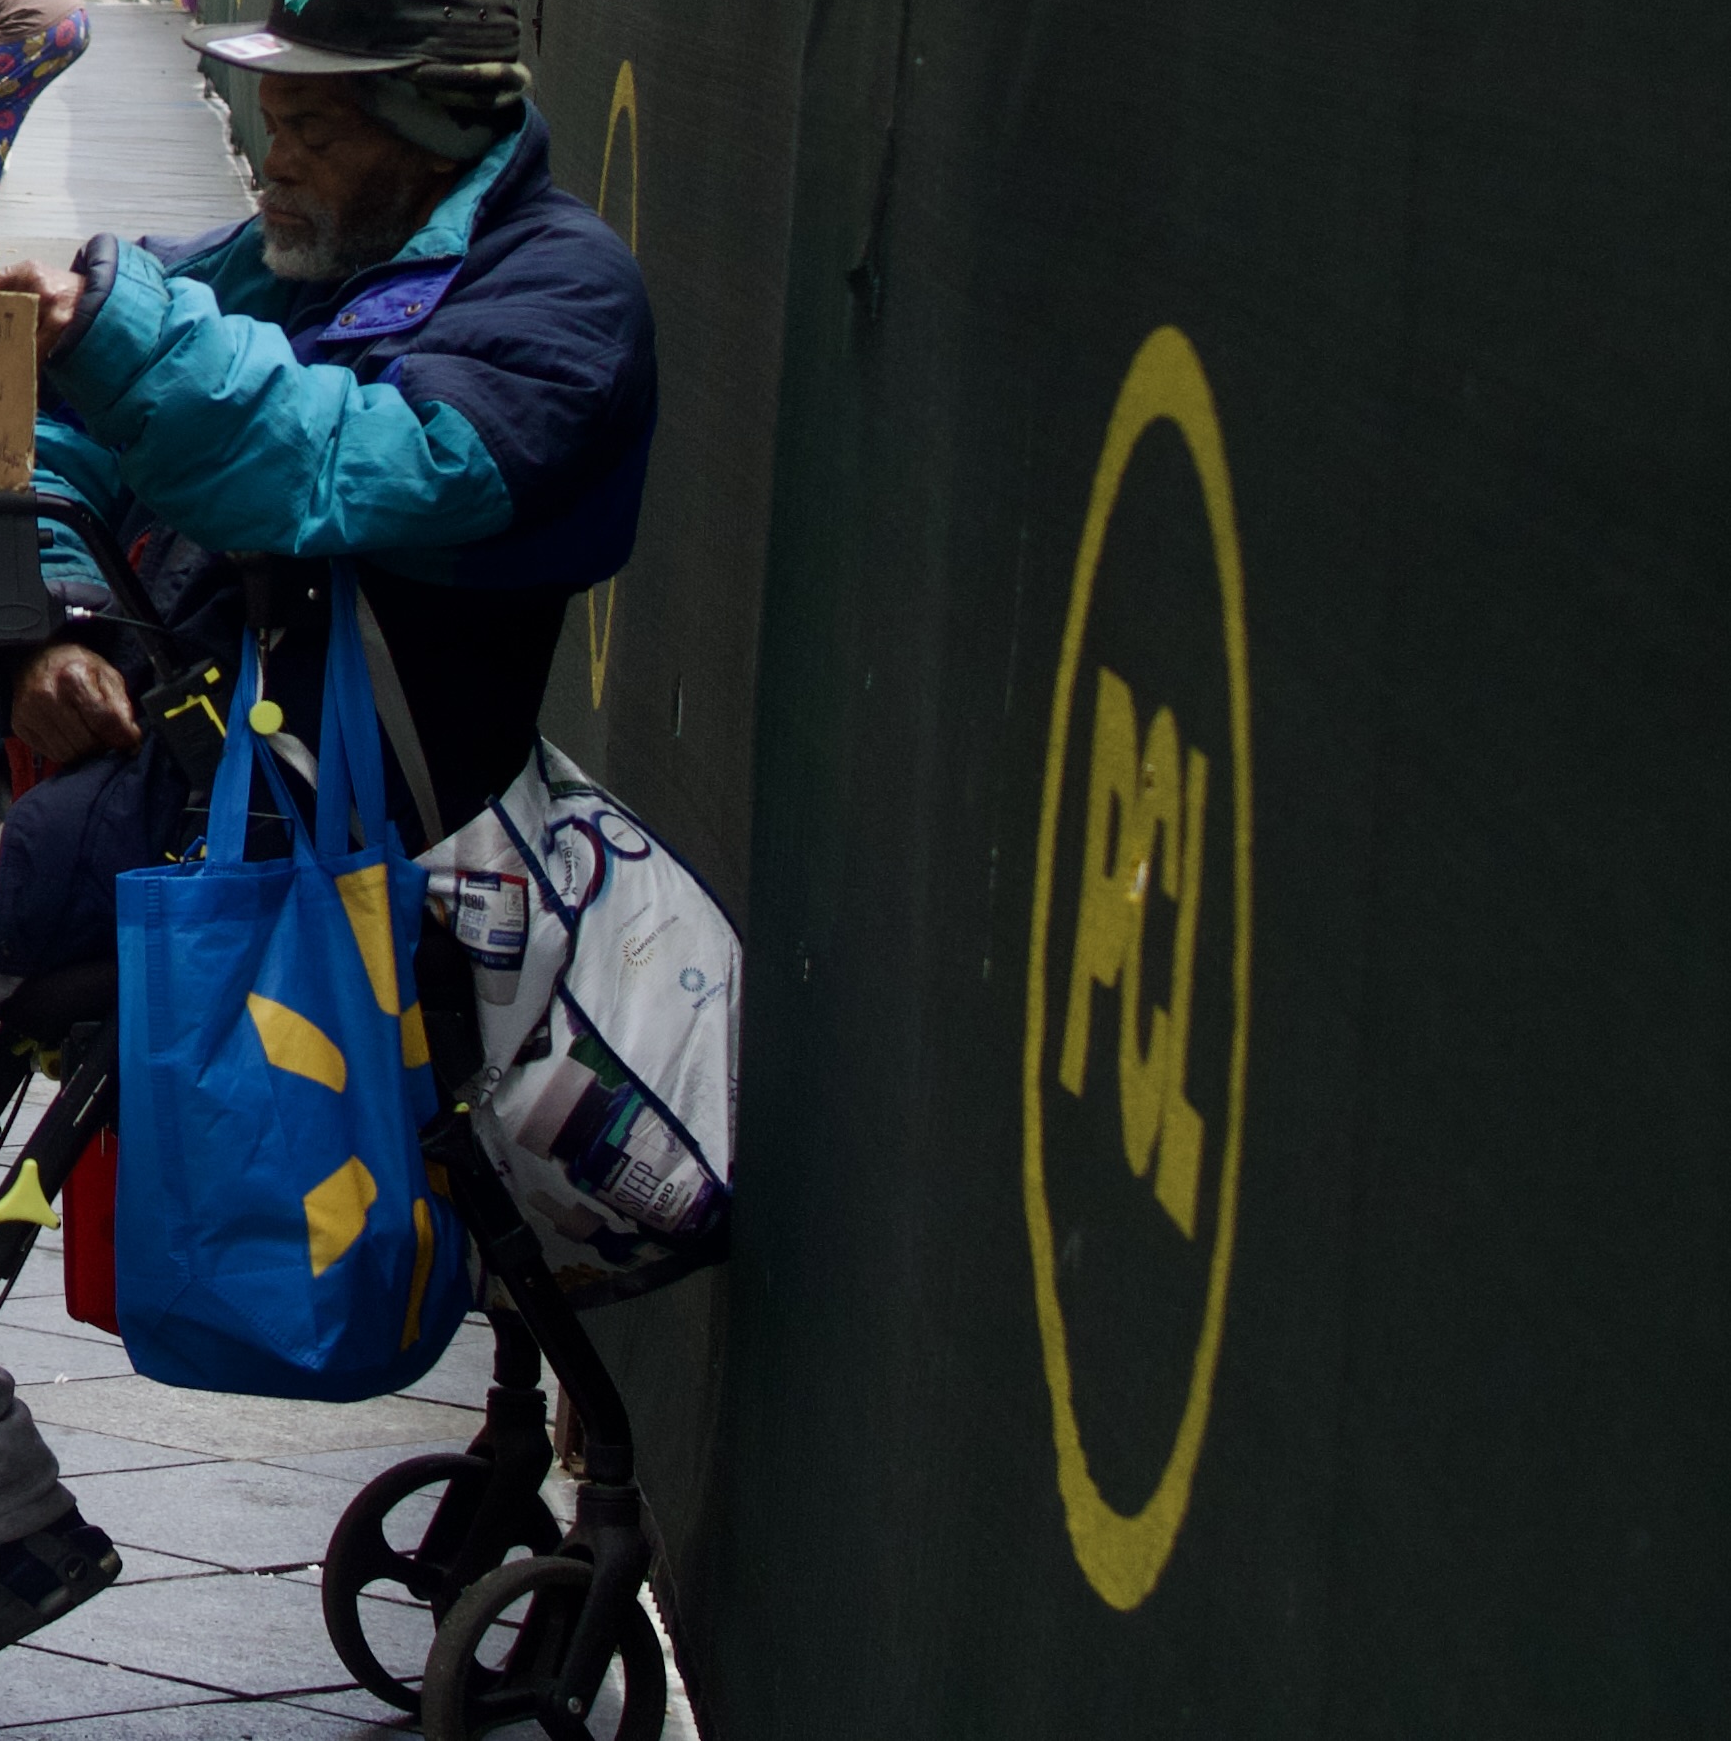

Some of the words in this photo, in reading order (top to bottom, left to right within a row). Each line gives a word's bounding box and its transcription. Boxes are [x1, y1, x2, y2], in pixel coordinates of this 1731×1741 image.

[1057, 664, 1211, 1240] PCL
[614, 1160, 662, 1213] SLEEP
[654, 1181, 677, 1213] CBD
